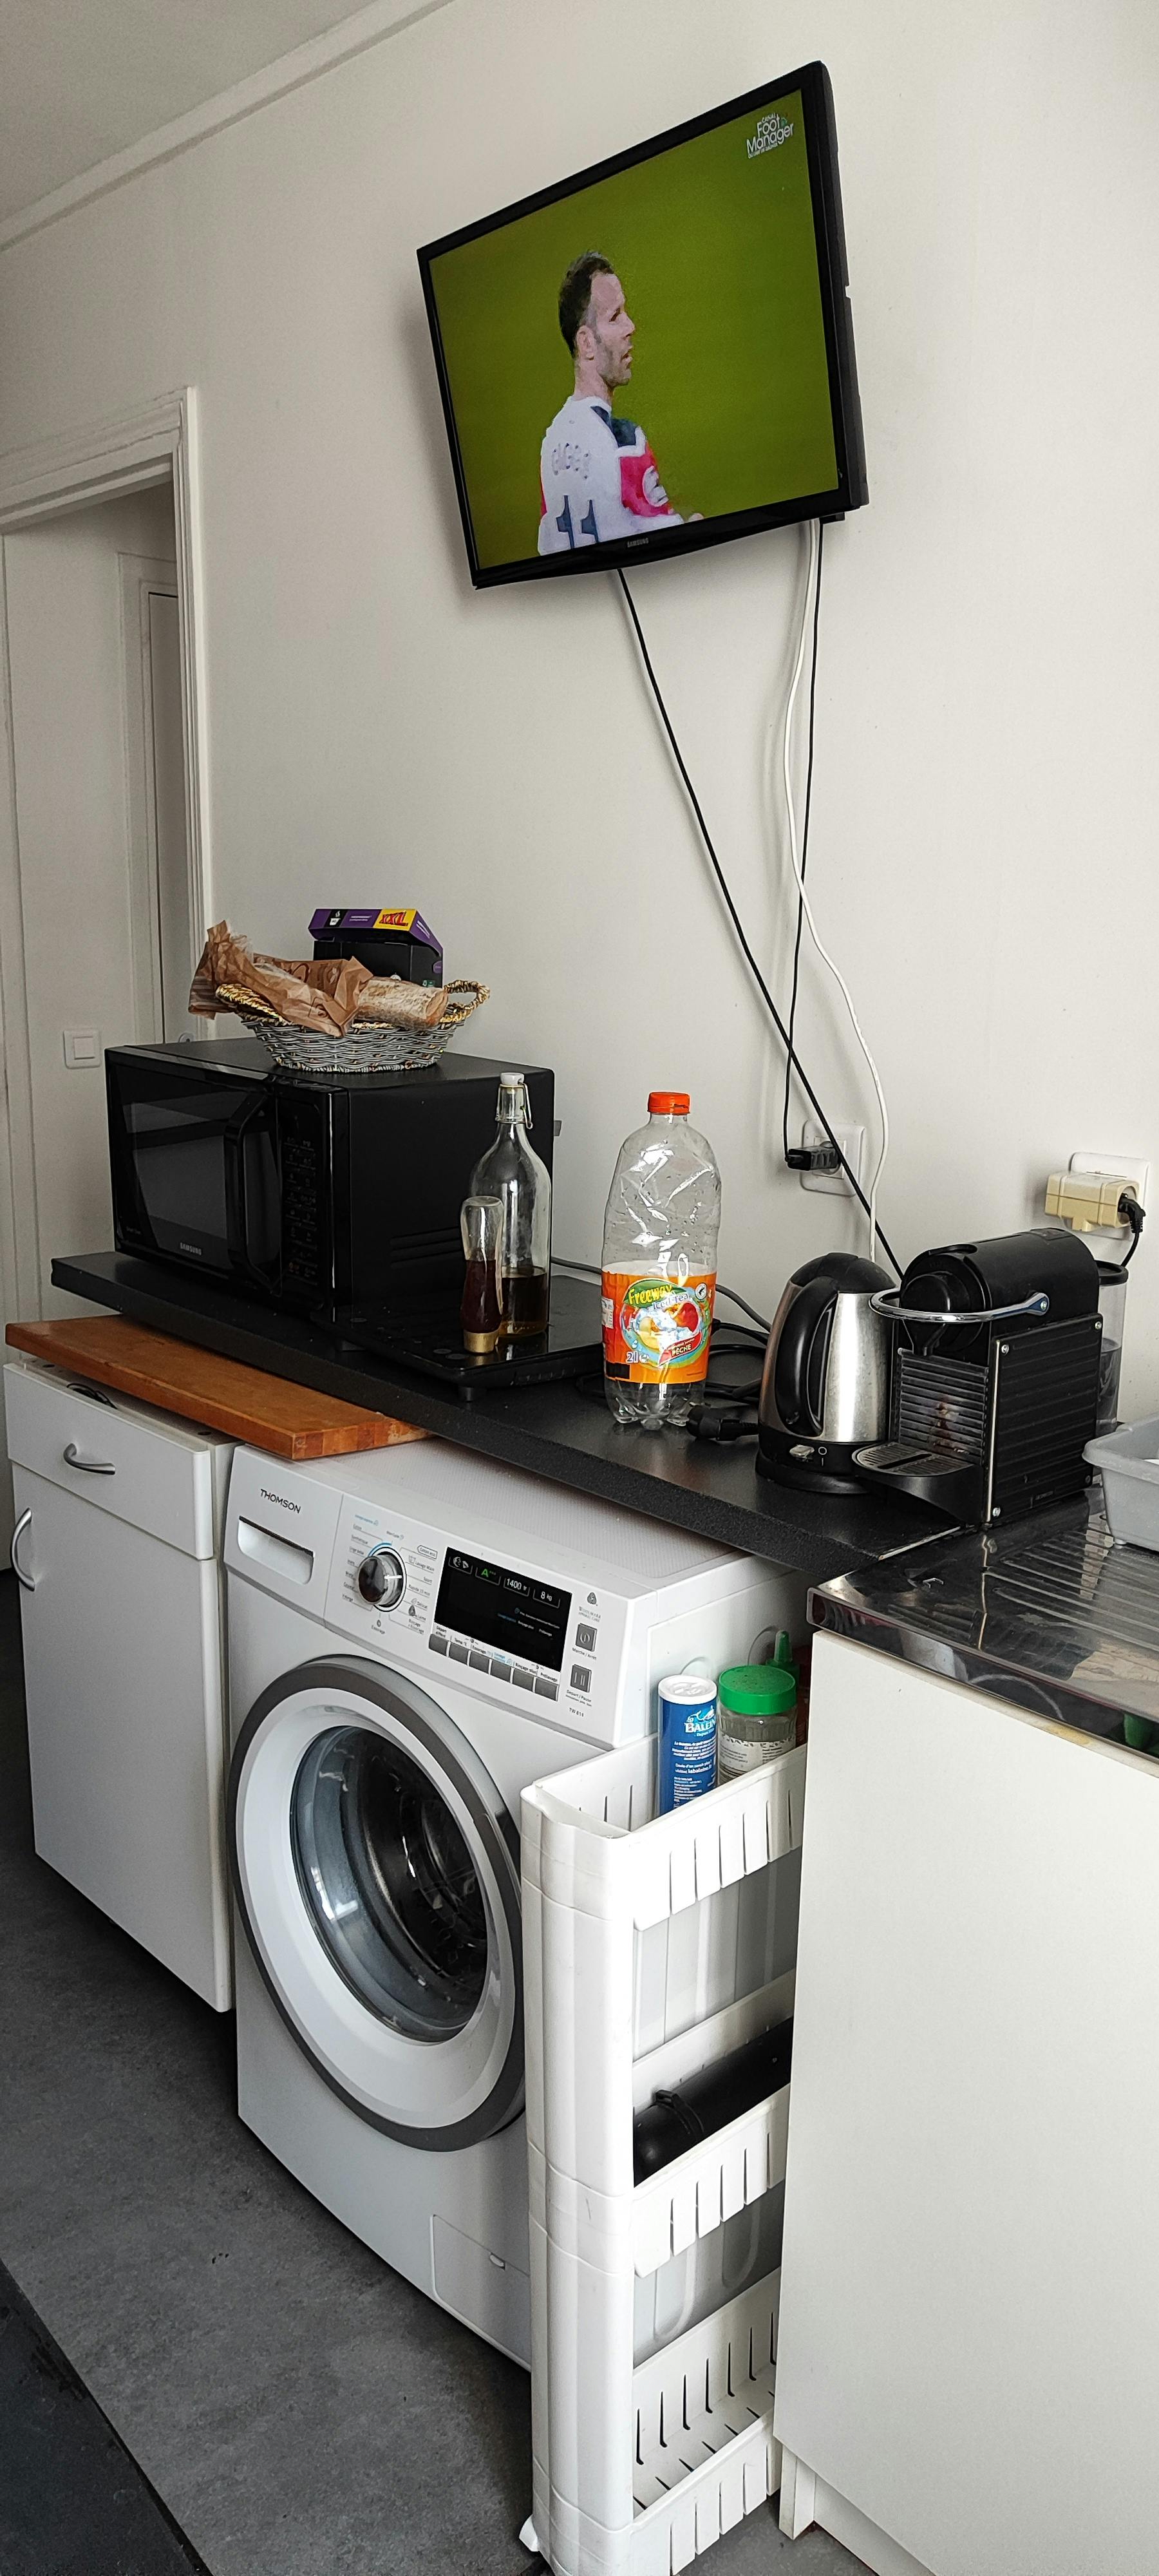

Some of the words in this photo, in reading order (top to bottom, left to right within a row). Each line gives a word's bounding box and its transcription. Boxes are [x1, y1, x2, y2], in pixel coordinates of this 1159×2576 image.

[757, 113, 780, 138] Foot
[747, 123, 793, 154] Manager
[379, 911, 408, 926] XXL
[180, 1242, 202, 1256] SAMSUNG
[628, 1285, 673, 1305] Freeway
[260, 1488, 301, 1514] THOMSON
[507, 1578, 522, 1590] 1400
[541, 1591, 546, 1600] 8
[546, 1593, 552, 1602] kg
[684, 1718, 716, 1733] BALEIN
